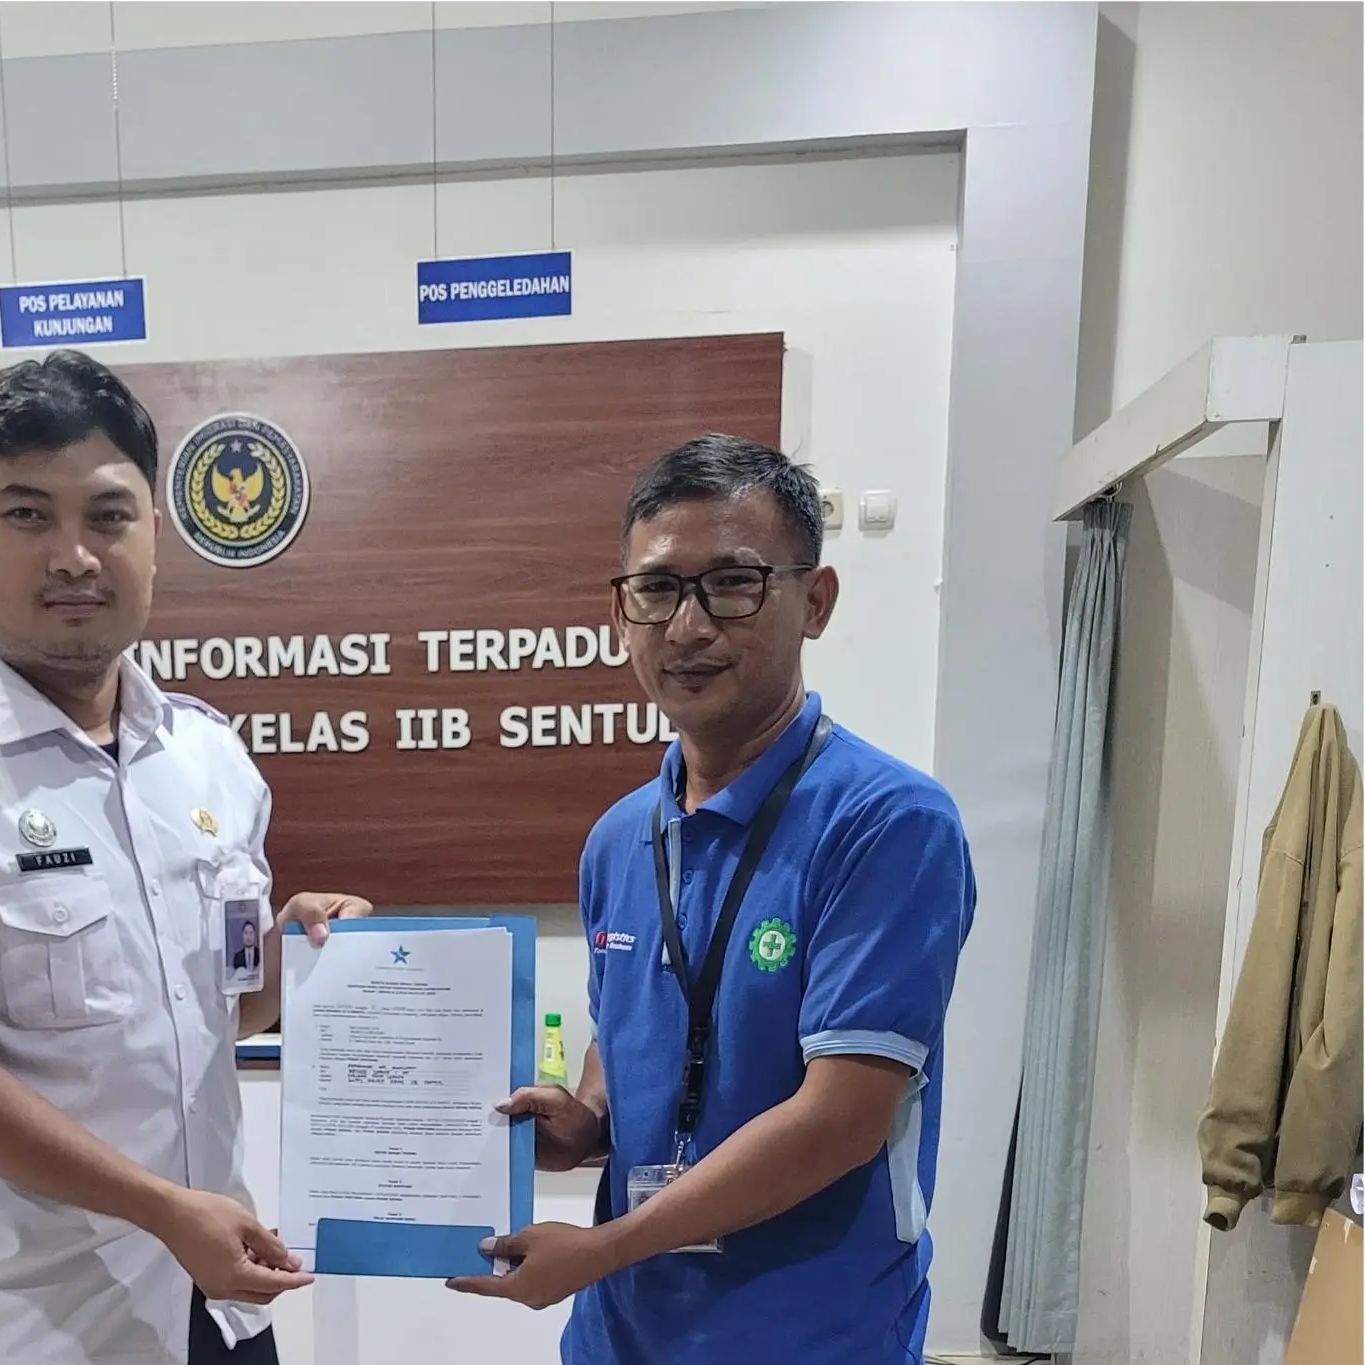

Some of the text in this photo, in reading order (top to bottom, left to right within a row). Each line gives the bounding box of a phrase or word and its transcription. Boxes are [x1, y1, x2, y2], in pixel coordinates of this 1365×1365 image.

[419, 275, 569, 302] POS PENGGELEDAHAN
[19, 290, 124, 313] POS PELAYANAN
[33, 316, 113, 337] KUNJUNGAN
[418, 625, 630, 673] TERPADU
[396, 708, 472, 750] IIB
[499, 702, 681, 748] SENTUL
[35, 853, 76, 866] FAUZI
